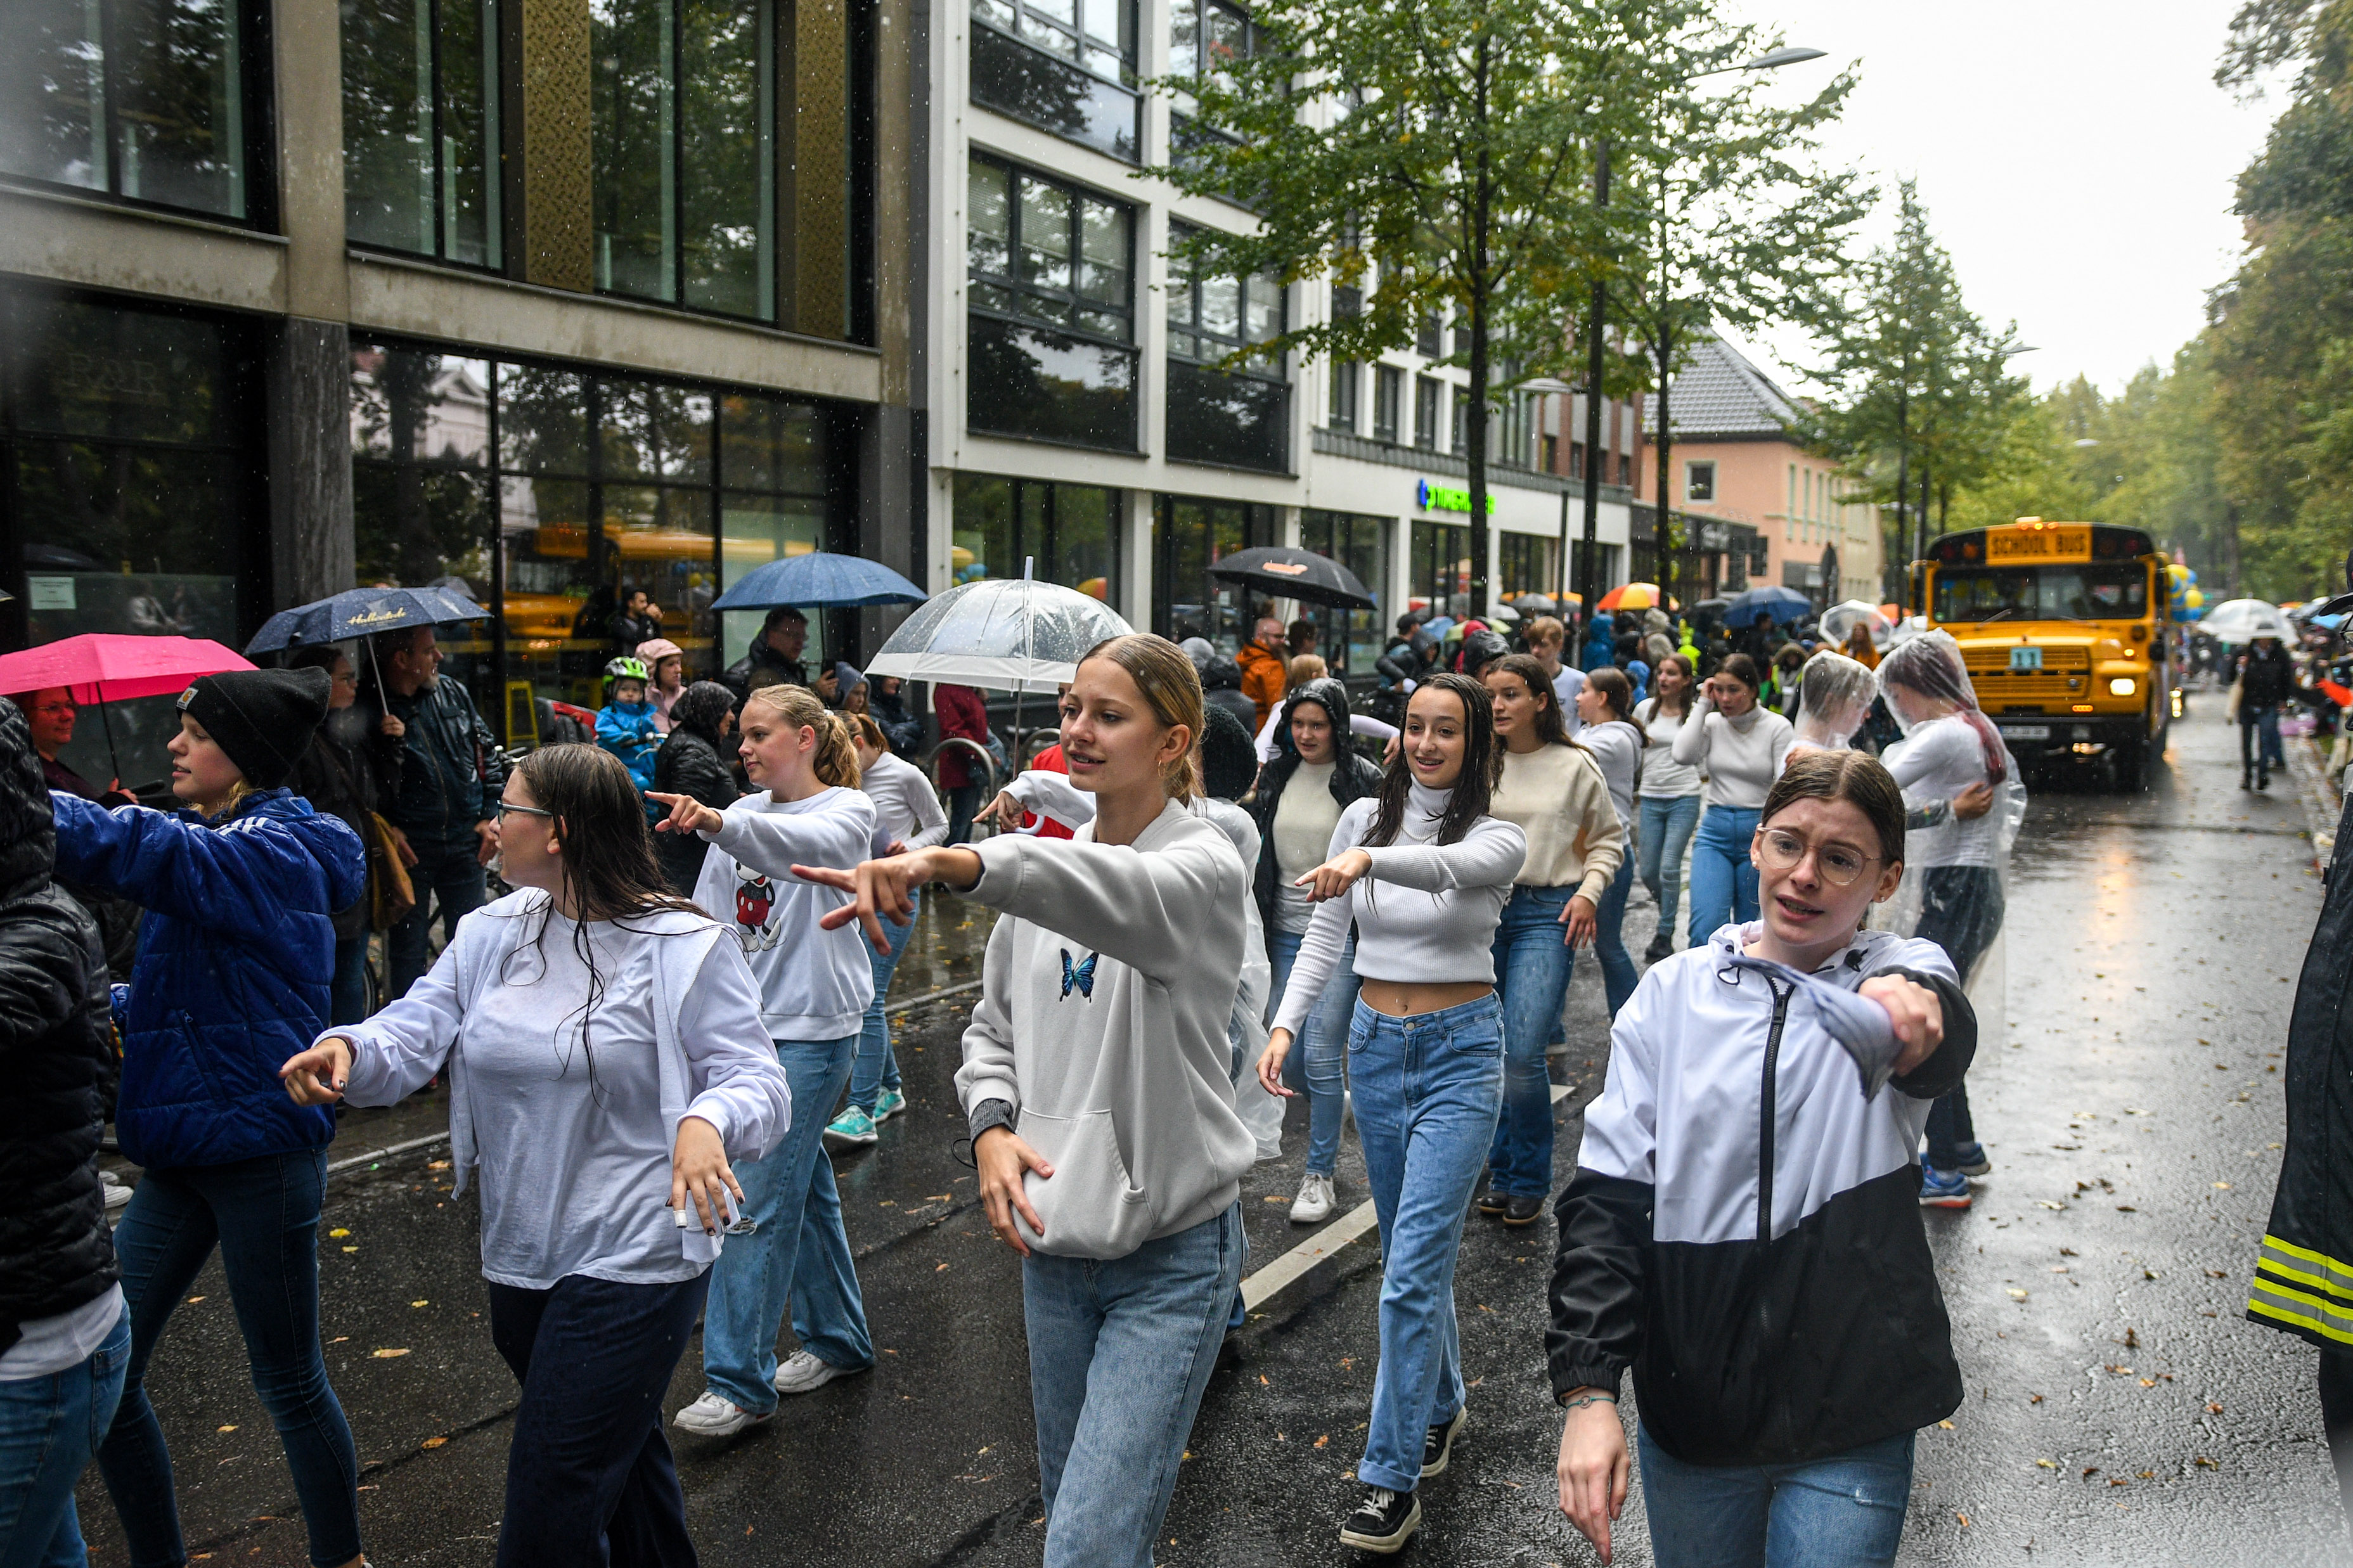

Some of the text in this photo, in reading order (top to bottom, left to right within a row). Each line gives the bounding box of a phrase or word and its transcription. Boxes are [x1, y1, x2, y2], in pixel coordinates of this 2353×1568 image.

[1992, 533, 2085, 555] SCHOOL BUS
[2015, 652, 2036, 665] 11
